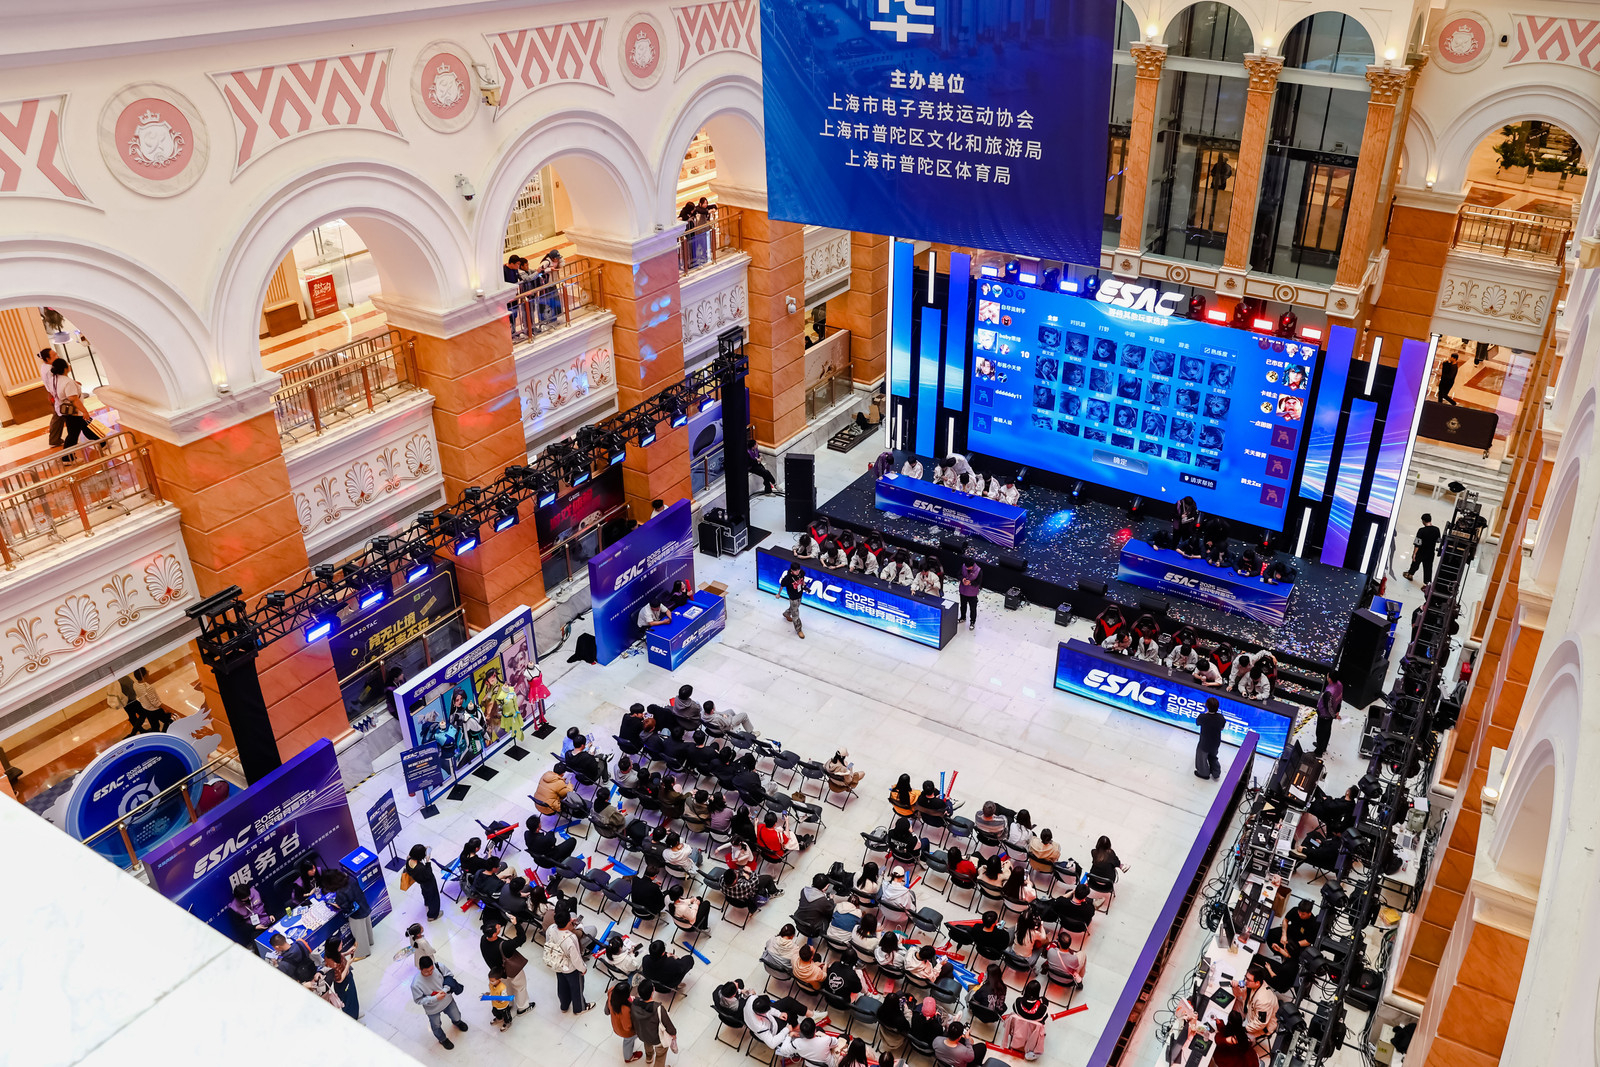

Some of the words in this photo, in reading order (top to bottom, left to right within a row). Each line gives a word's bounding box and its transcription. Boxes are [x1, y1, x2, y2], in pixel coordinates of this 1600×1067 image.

[890, 69, 965, 94] 主办单位
[827, 92, 1034, 131] 上海市电子竞技运动协会
[819, 120, 1043, 161] 上海市普陀区文化和旅游局
[845, 149, 1011, 185] 上海市普陀区体育局
[1096, 279, 1185, 316] ESAC
[1020, 350, 1030, 358] 10
[1113, 456, 1128, 466] 确定
[912, 500, 942, 514] ESAC
[614, 558, 646, 590] ESAC
[1164, 572, 1199, 588] ESAC
[845, 590, 875, 606] 2025
[845, 600, 916, 629] 全民电竞嘉年华
[1084, 669, 1166, 706] ESAC
[1168, 694, 1206, 712] 2025
[93, 775, 124, 802] ESAC
[254, 806, 281, 828] 2025
[193, 824, 252, 880] ESAC
[229, 832, 300, 894] 服务台
